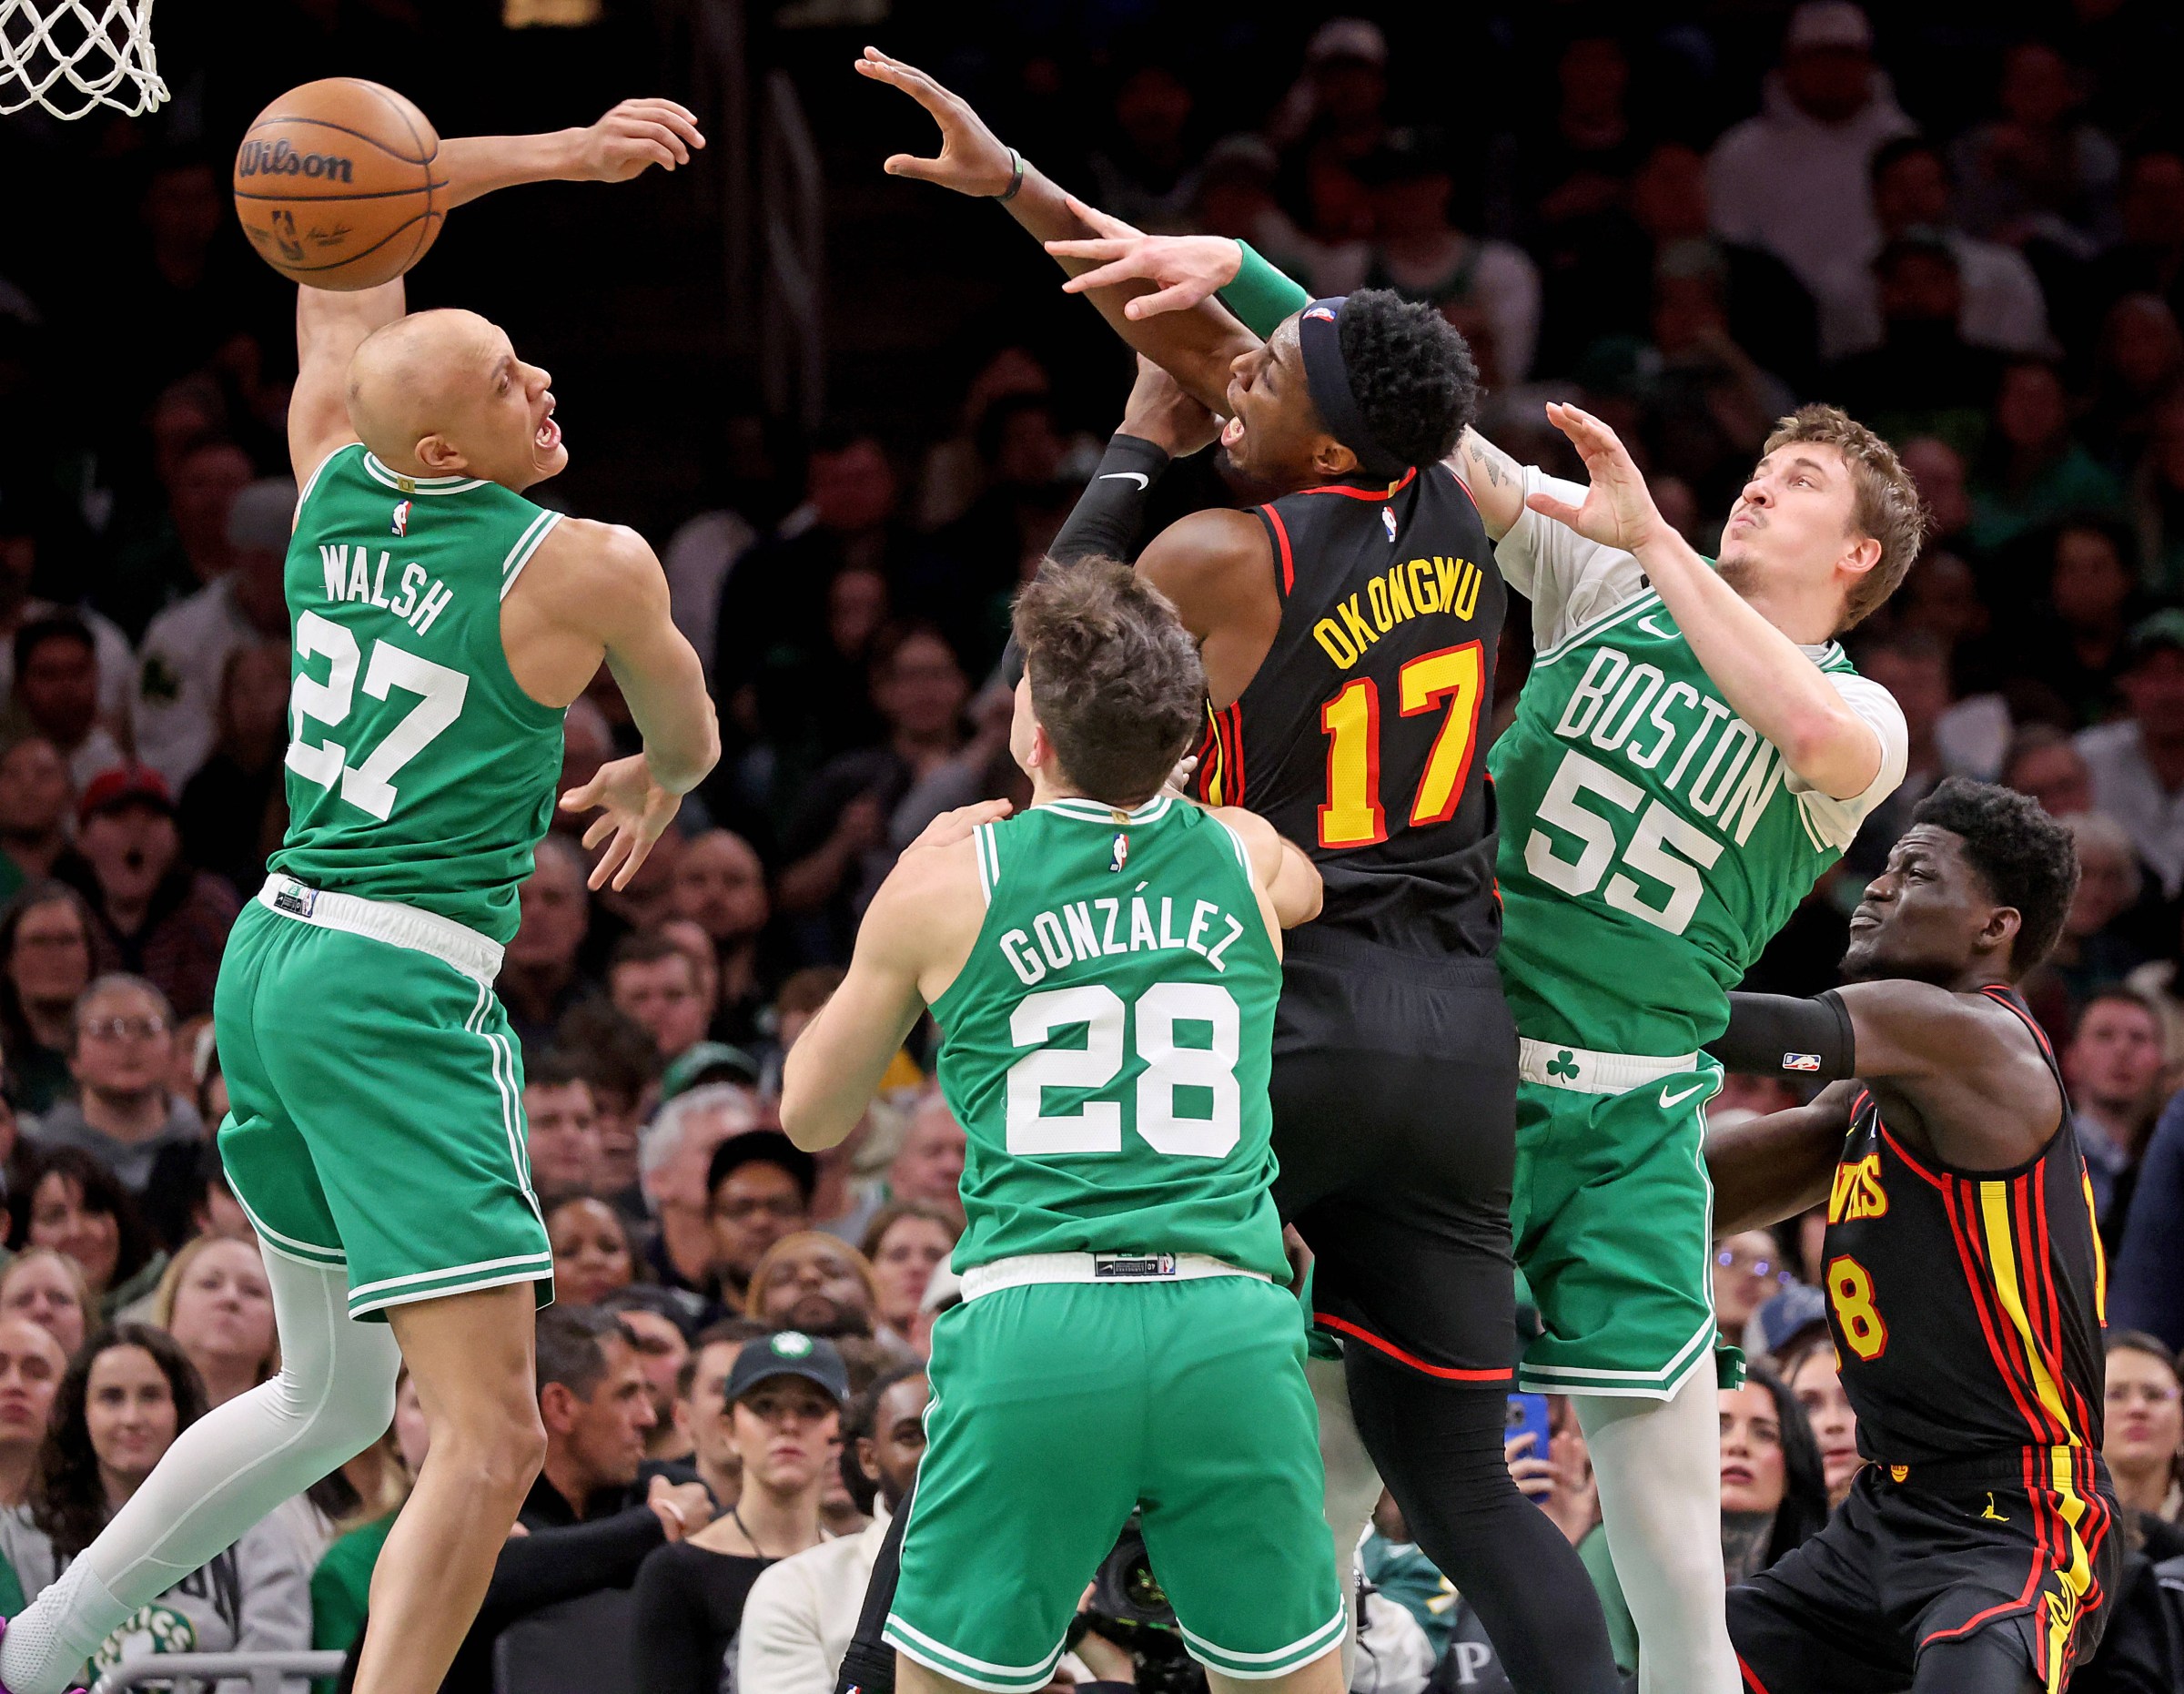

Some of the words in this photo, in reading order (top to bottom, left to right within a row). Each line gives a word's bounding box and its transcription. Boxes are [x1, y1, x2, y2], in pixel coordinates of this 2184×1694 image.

[239, 138, 353, 183] Wilson
[319, 544, 453, 636] WALSH
[1313, 556, 1482, 669] OKONGWU
[284, 609, 470, 821] 27
[1318, 638, 1484, 848] 17
[1553, 645, 1785, 847] BOSTON
[1523, 748, 1724, 936] 55
[999, 880, 1244, 985] GONZÁLEZ
[1006, 982, 1240, 1159] 28
